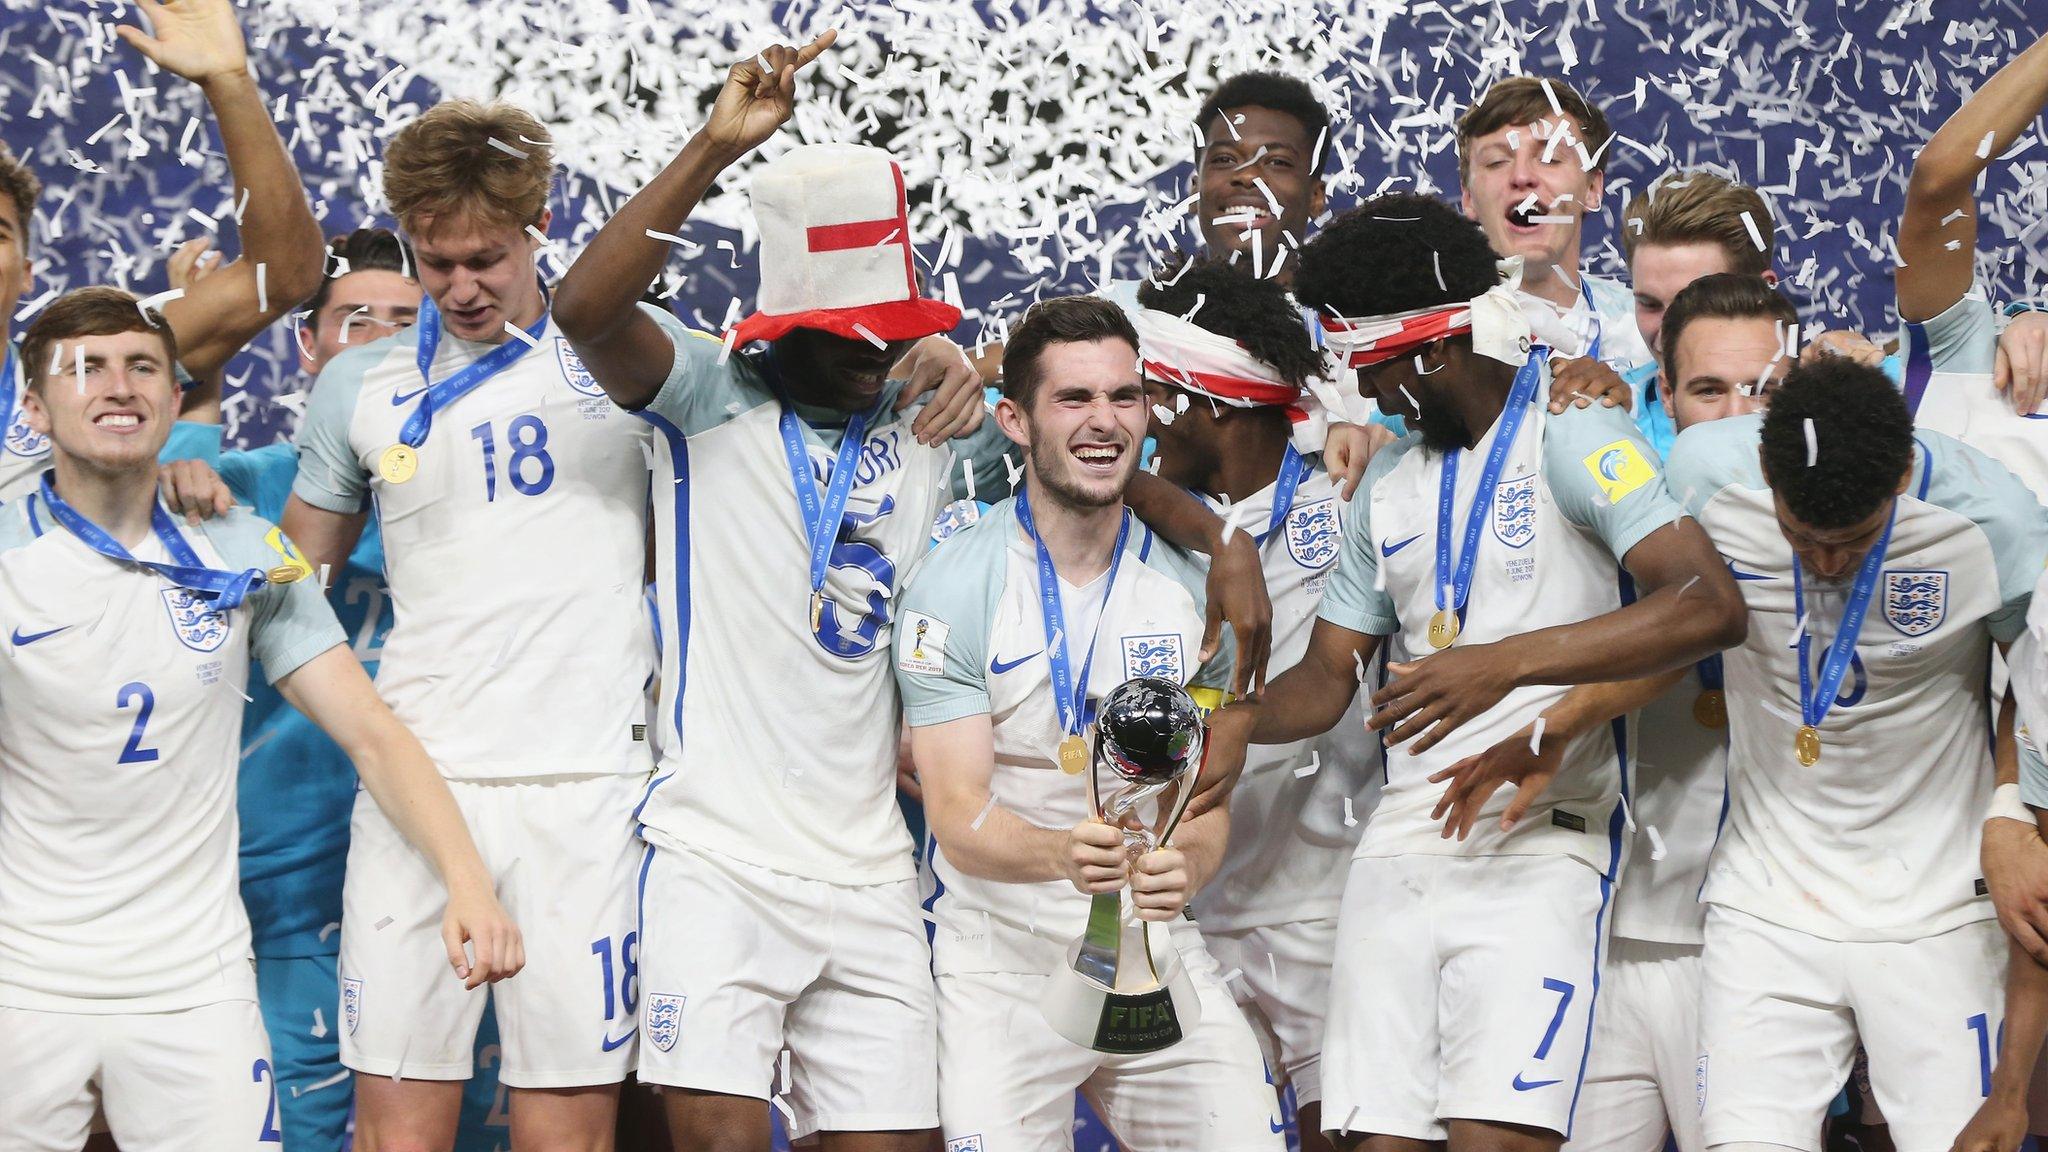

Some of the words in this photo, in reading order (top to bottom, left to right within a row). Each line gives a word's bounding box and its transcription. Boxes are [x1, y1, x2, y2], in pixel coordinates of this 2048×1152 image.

[471, 414, 555, 502] 18
[117, 682, 158, 764] 2
[1063, 750, 1083, 761] FIFA
[1110, 1003, 1170, 1029] FIFA
[1533, 977, 1575, 1061] 7
[253, 1059, 281, 1142] 2
